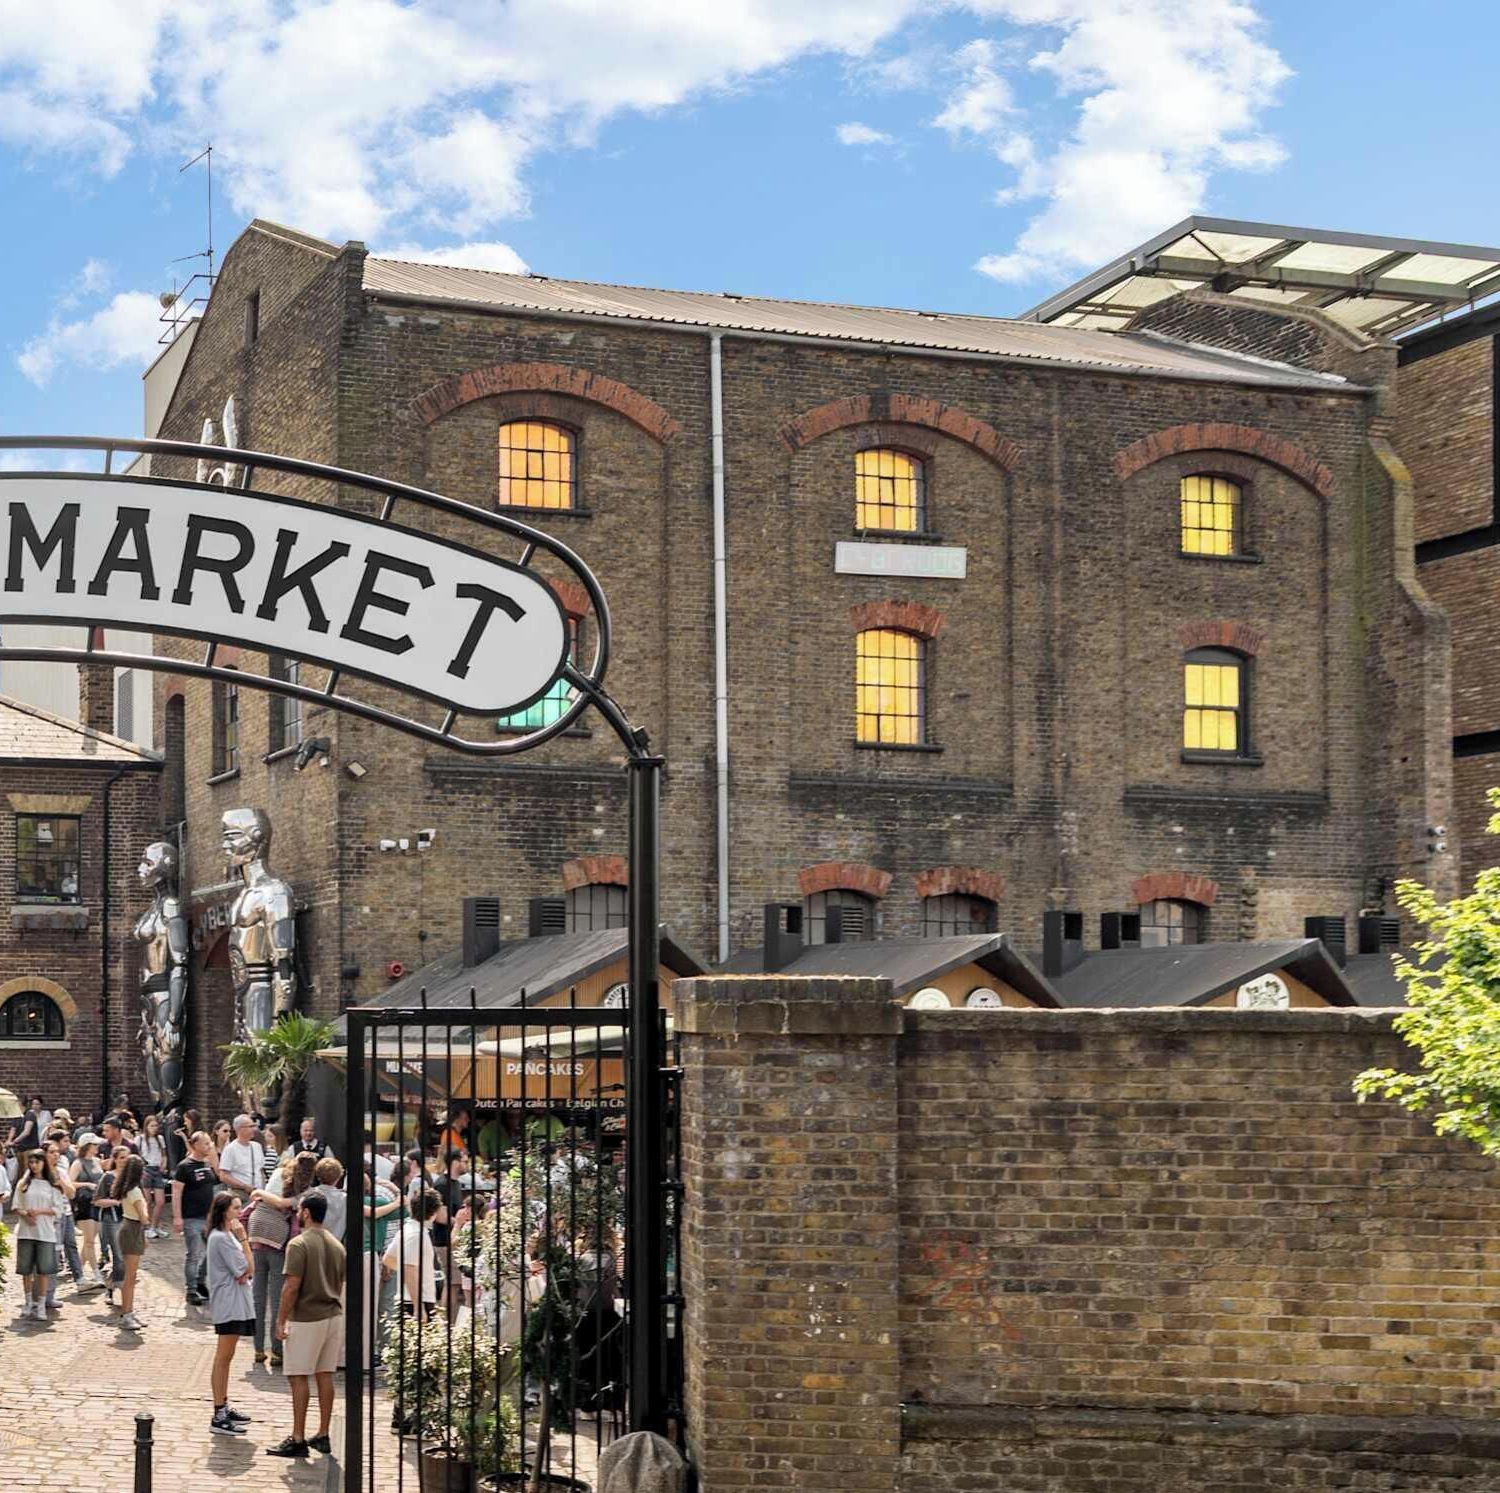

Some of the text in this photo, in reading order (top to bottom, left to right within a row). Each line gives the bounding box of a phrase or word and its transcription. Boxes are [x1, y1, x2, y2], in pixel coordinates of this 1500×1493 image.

[4, 502, 526, 680] MARKET
[506, 1063, 584, 1076] PANCAKES
[566, 1099, 608, 1110] Belgin
